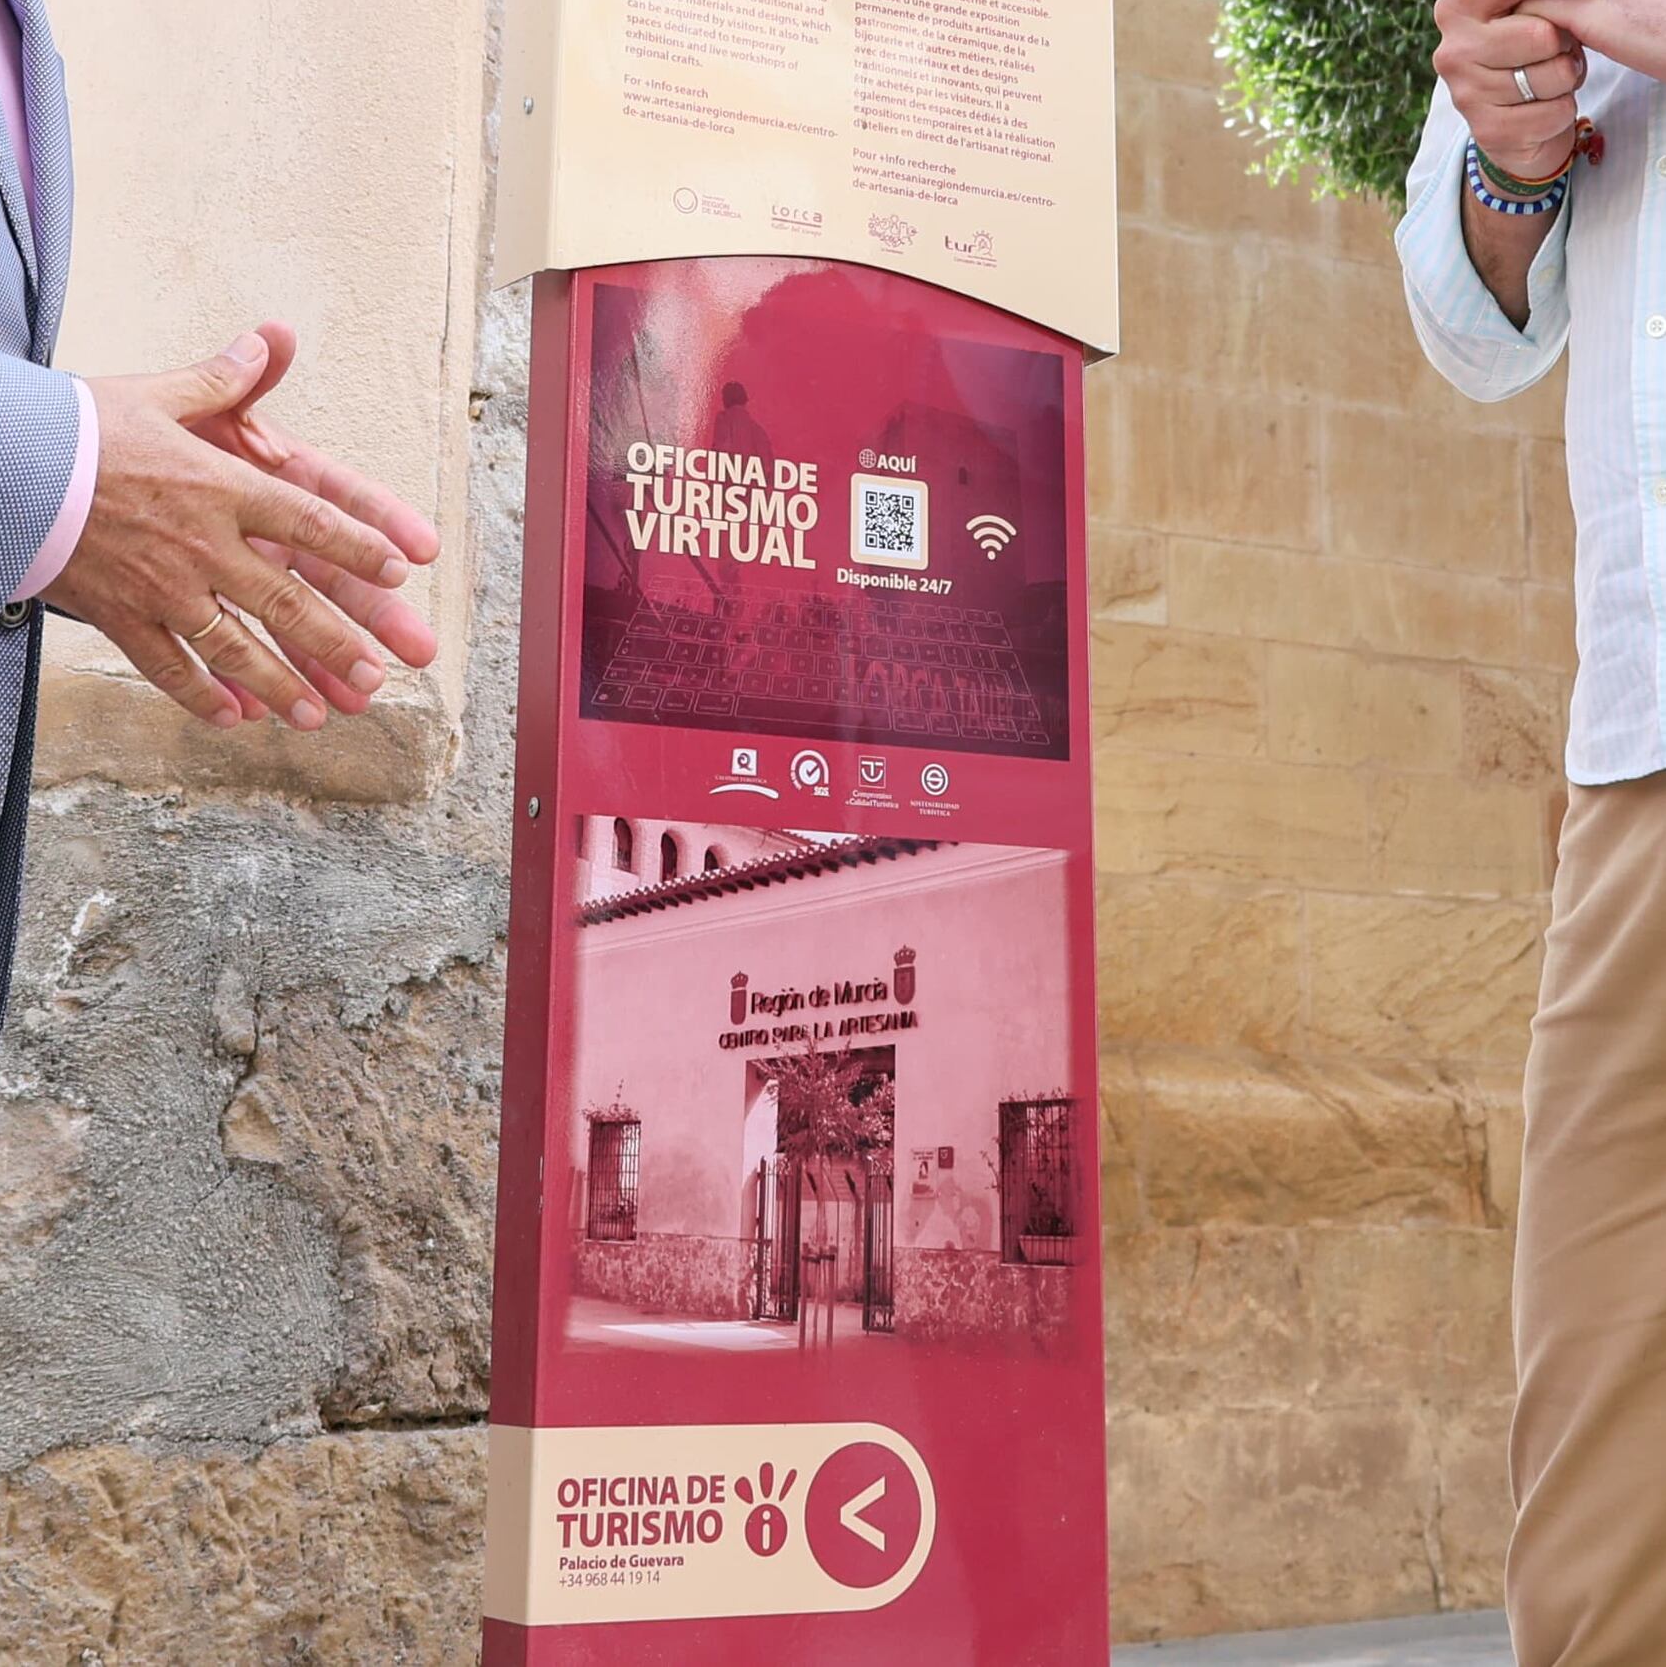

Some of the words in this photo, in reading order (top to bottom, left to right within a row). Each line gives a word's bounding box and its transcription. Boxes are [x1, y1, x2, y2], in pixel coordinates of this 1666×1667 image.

[932, 3, 967, 16] grande
[970, 10, 1019, 26] exposition
[853, 147, 876, 160] Pour
[907, 159, 955, 174] recherche
[626, 441, 767, 487] OFICINA
[773, 459, 818, 494] DE
[876, 453, 917, 473] AQUÍ
[625, 473, 818, 531] TURISMO
[625, 509, 816, 570] VIRTUAL
[836, 567, 917, 592] Disponible
[919, 577, 952, 595] 24/7
[751, 987, 804, 1017] Región
[808, 985, 830, 1008] de
[834, 977, 888, 1005] Murcia
[719, 1029, 768, 1049] CENTRO
[814, 1022, 834, 1040] LA
[557, 1476, 679, 1508] OFICINA
[687, 1475, 725, 1504] DE
[556, 1509, 723, 1548] TURISMO
[559, 1555, 607, 1570] Palacio
[610, 1555, 626, 1568] de
[629, 1554, 684, 1567] Guevara
[559, 1573, 583, 1587] +34
[585, 1572, 607, 1586] 968
[610, 1572, 625, 1585] 44
[630, 1571, 643, 1584] 19
[647, 1571, 660, 1583] 14
